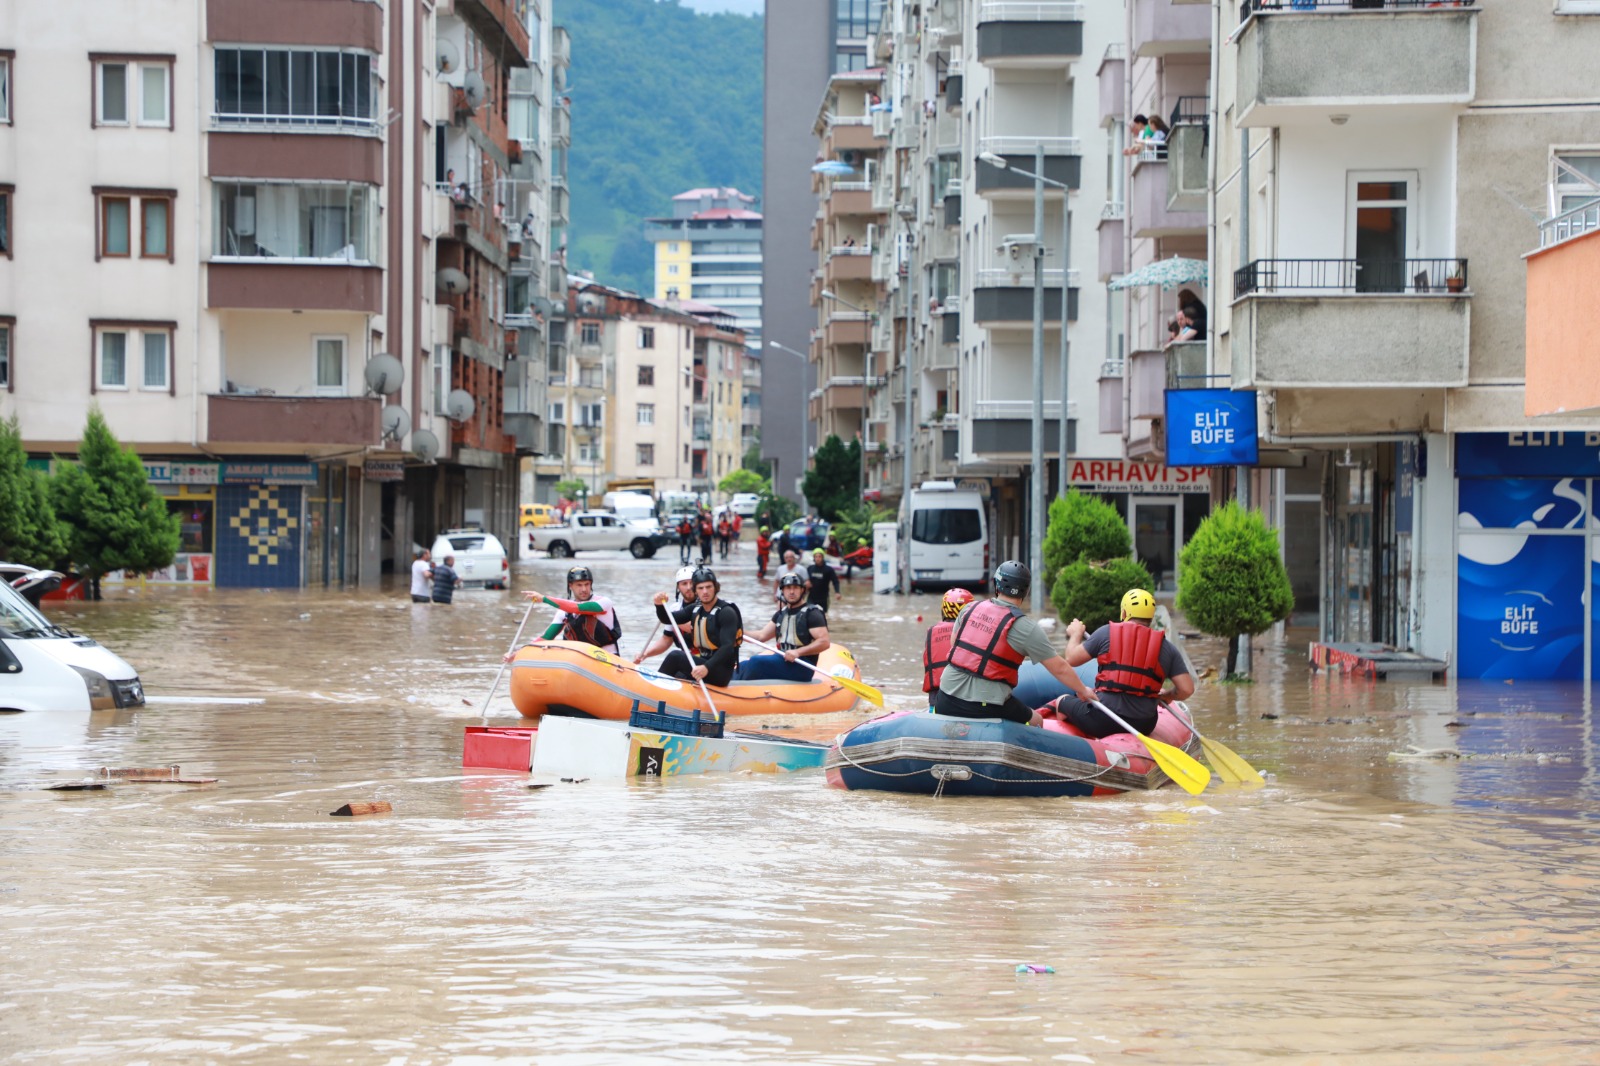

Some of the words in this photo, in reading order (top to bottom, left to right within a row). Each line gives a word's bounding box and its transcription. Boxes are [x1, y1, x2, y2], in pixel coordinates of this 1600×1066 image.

[1195, 408, 1230, 427] ELİT
[1191, 426, 1235, 445] BÜFE
[1175, 465, 1212, 482] SP
[1504, 603, 1535, 620] ELİT
[970, 620, 993, 634] RAFTING
[1500, 618, 1539, 635] BÜFE
